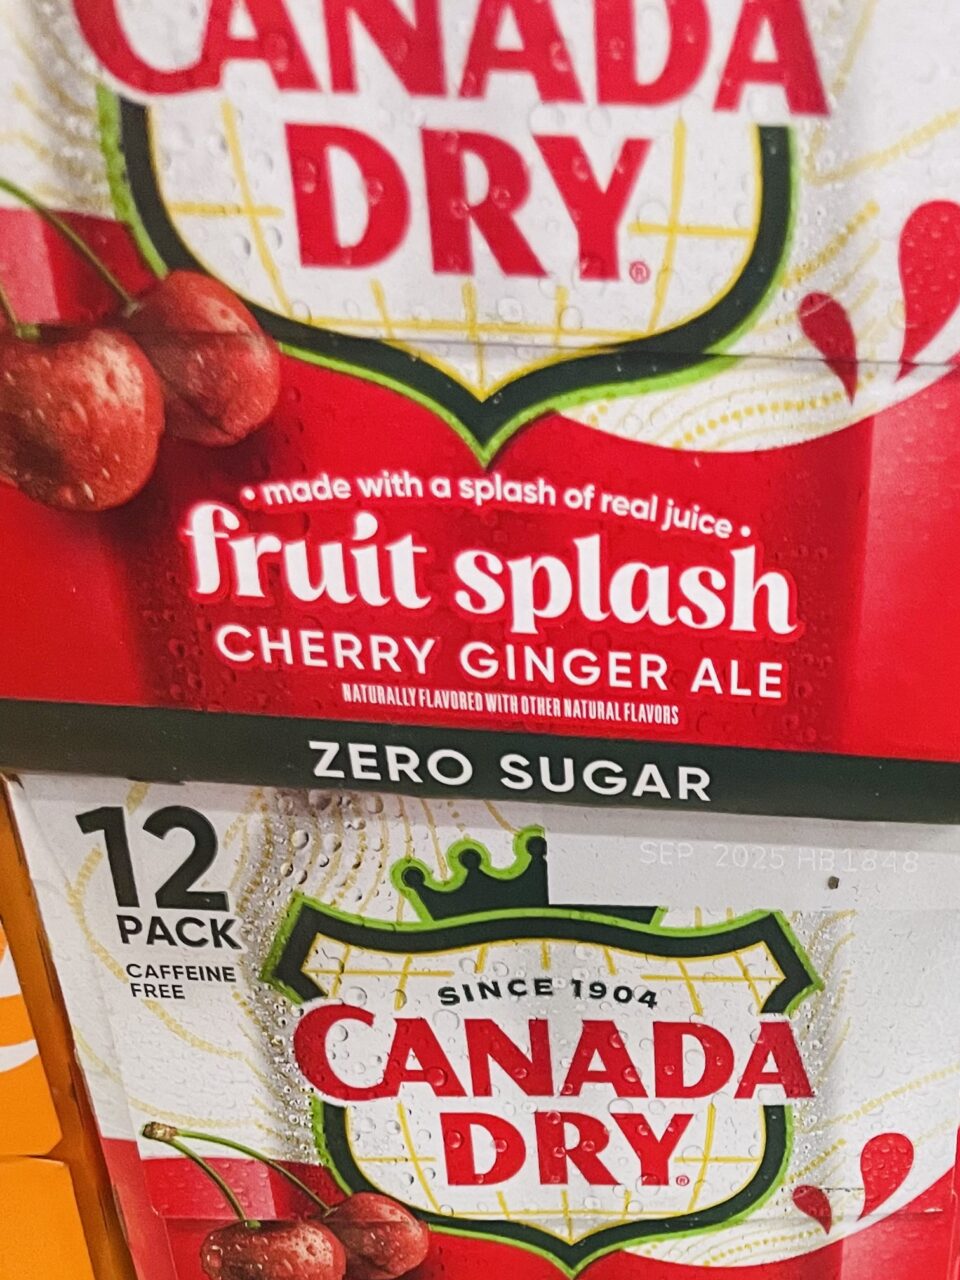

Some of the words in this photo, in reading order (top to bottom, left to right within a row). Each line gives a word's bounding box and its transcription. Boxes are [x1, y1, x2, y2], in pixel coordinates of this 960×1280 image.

[71, 0, 833, 116] CANADA
[284, 123, 651, 283] DRY
[262, 473, 351, 505] made
[357, 470, 423, 498] with
[431, 477, 451, 499] a
[459, 473, 556, 507] splash
[563, 484, 595, 511] of
[601, 494, 658, 522] real
[660, 499, 733, 539] juice
[185, 504, 431, 608] fruit
[453, 534, 798, 635] splash
[215, 624, 437, 674] CHERRY
[459, 642, 668, 690] GINGER
[691, 657, 783, 699] ALE
[342, 683, 415, 708] NATURALLY
[419, 690, 483, 713] FLAVORED
[486, 694, 518, 715] WITH
[521, 696, 561, 718] OTHER
[563, 698, 621, 721] NATURAL
[624, 703, 679, 725] FLAVORS
[308, 740, 473, 786] ZERO
[500, 753, 711, 802] SUGAR
[76, 804, 230, 912] 12
[640, 842, 694, 865] SEP
[713, 844, 784, 870] 2025
[115, 915, 242, 950] PACK
[126, 963, 237, 983] CAFFEINE
[130, 983, 186, 999] FREE
[438, 978, 553, 1006] SINCE
[571, 979, 658, 1009] 1904
[293, 1003, 814, 1101] CANADA
[440, 1110, 694, 1187] DRY
